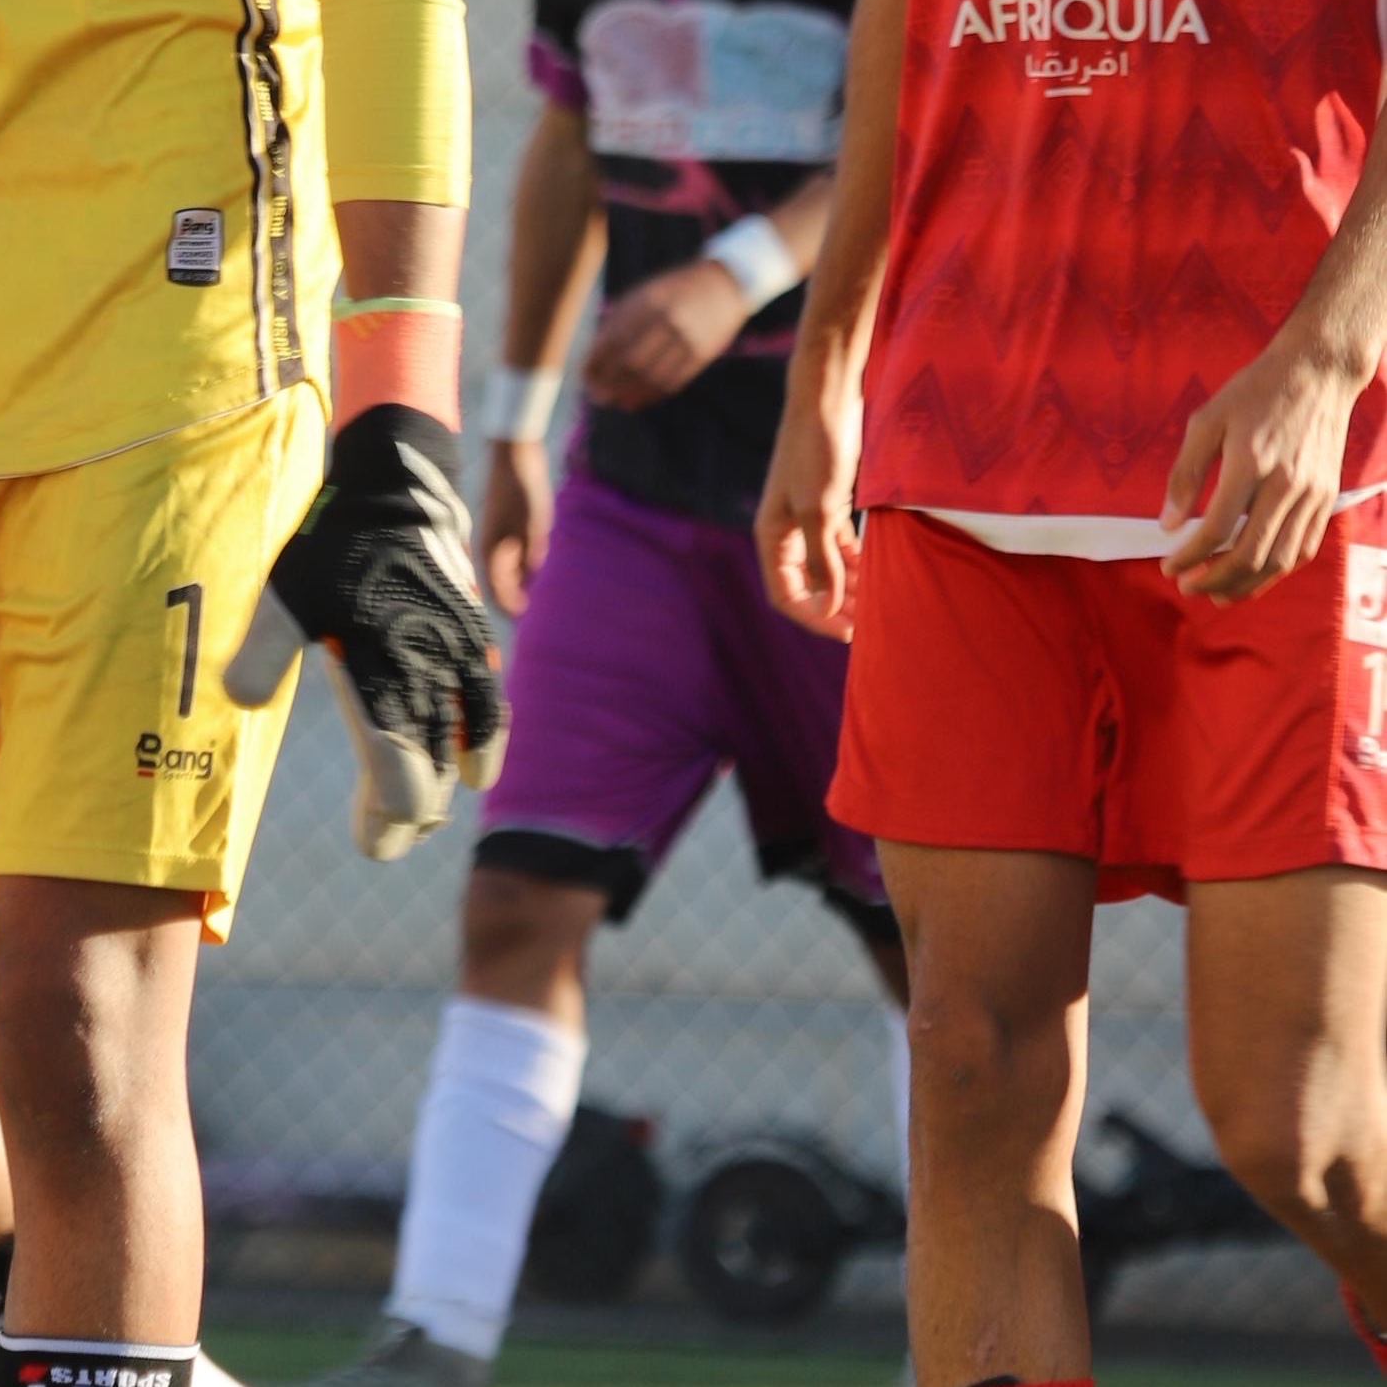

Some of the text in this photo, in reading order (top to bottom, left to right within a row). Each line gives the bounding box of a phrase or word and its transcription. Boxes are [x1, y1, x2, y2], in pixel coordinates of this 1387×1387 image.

[1024, 50, 1129, 84] افريقيا
[167, 583, 203, 719] 1
[135, 733, 213, 780] Bang
